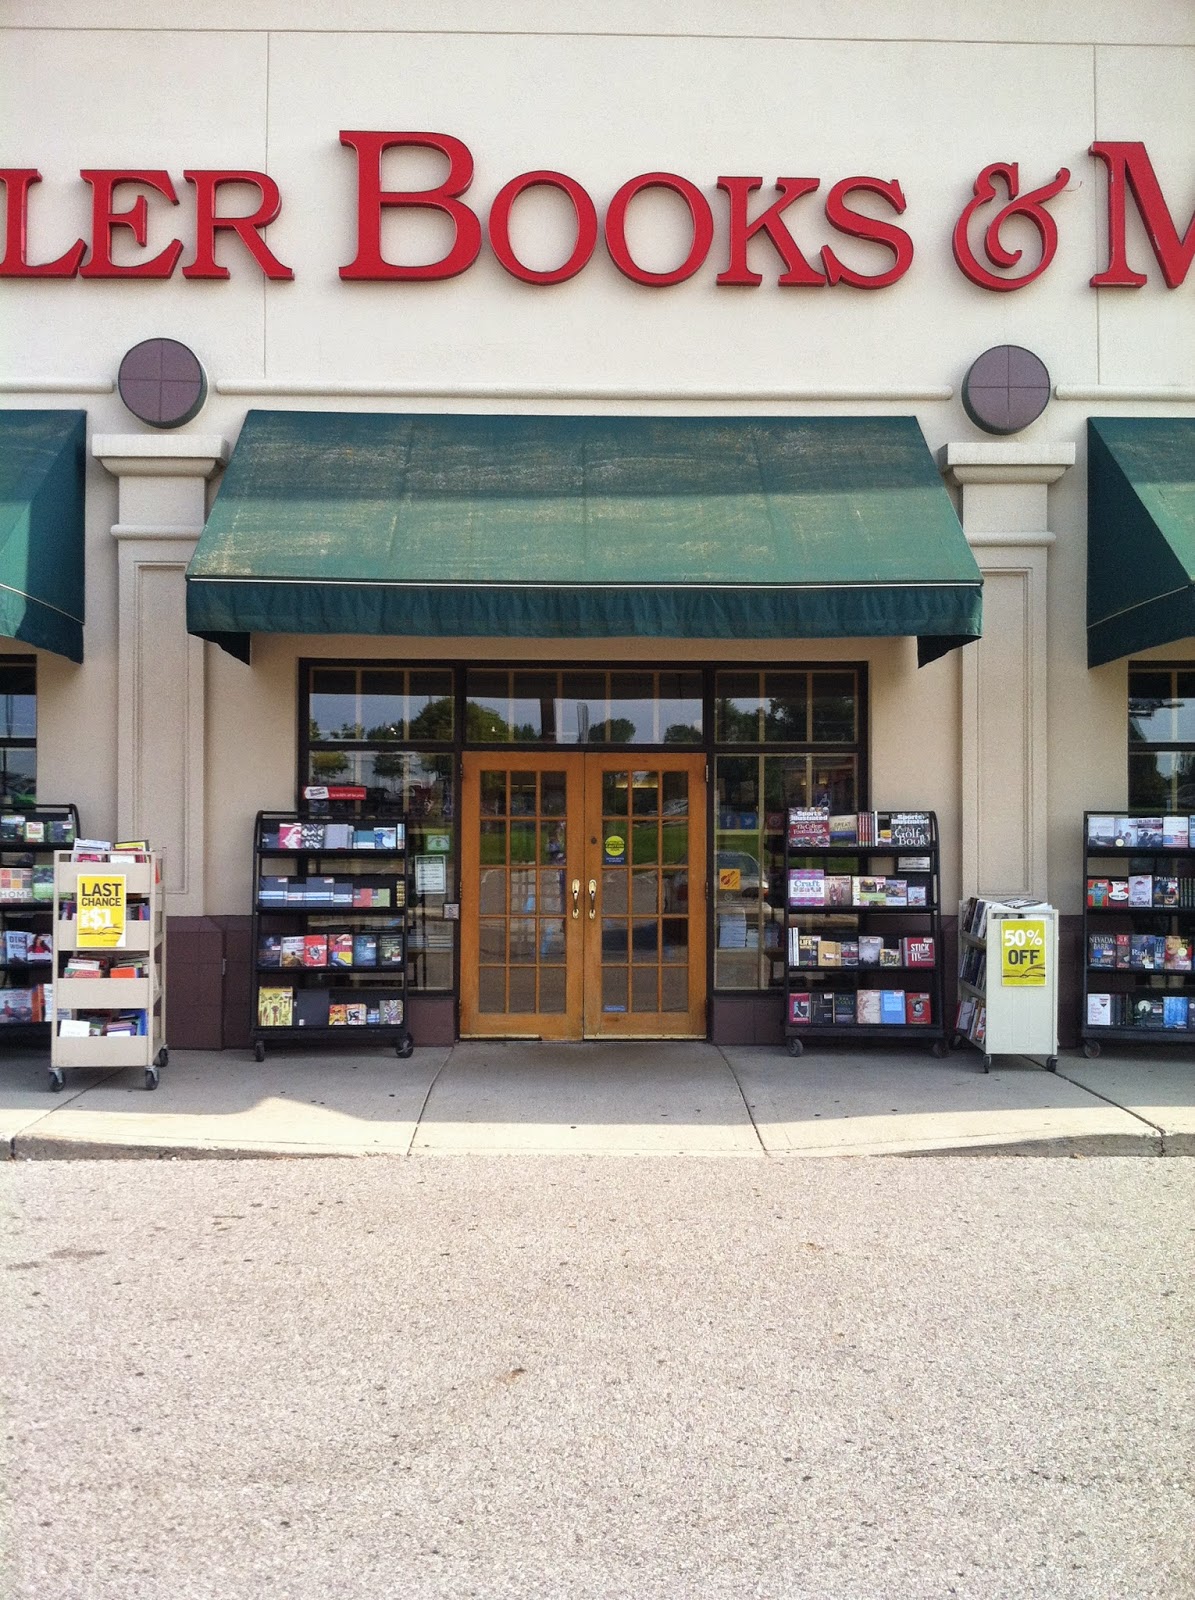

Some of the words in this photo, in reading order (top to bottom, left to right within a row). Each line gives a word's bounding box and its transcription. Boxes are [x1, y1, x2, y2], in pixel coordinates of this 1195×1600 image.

[338, 130, 914, 290] BOOKS
[951, 162, 1071, 292] &
[82, 883, 122, 897] LAST
[81, 897, 122, 907] CHANCE
[1004, 929, 1043, 947] 50%
[910, 943, 930, 952] STICK
[1008, 949, 1040, 965] OFF
